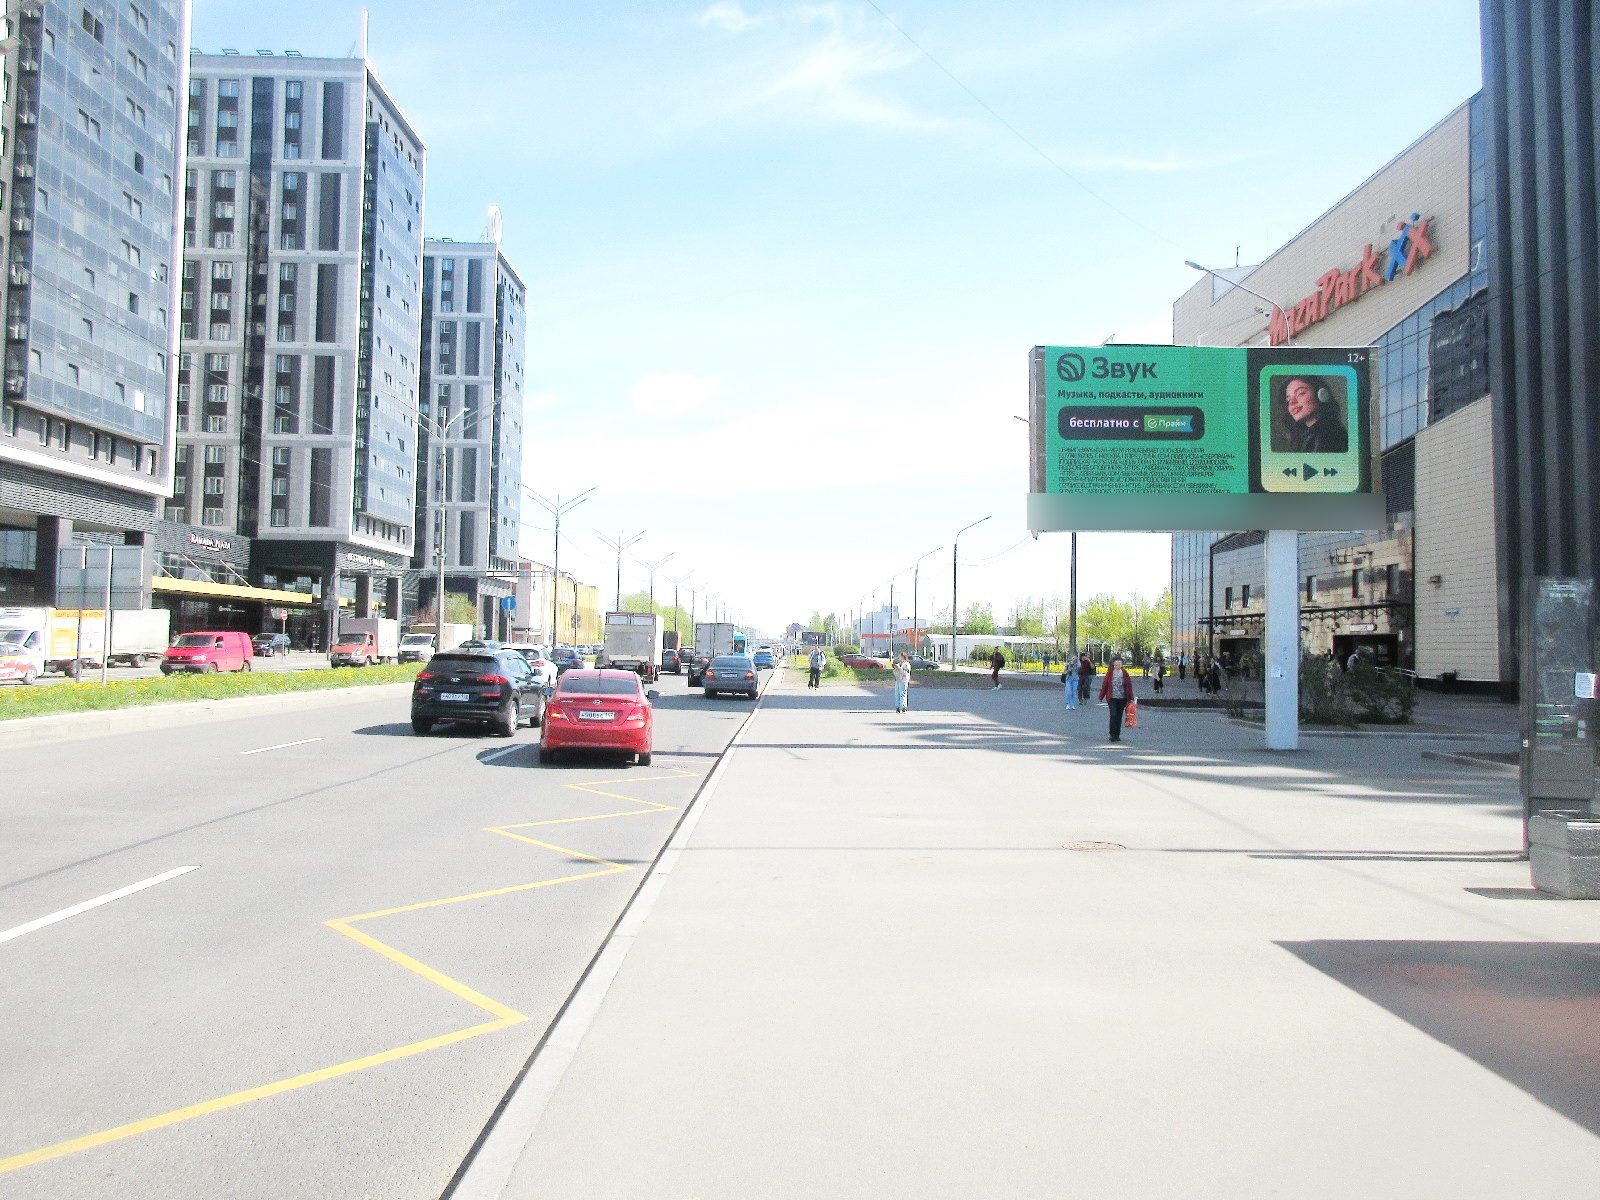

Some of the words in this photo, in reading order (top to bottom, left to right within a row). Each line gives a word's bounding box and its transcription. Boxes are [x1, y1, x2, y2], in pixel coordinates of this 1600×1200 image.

[1347, 353, 1366, 363] 12+
[1091, 356, 1158, 383] Звук
[1057, 389, 1097, 400] Музыка,
[1098, 390, 1148, 400] подкасты,
[1149, 390, 1204, 400] аудиокниги
[1069, 416, 1130, 428] бесплатно
[1133, 419, 1139, 428] с
[1158, 416, 1187, 429] Прайм
